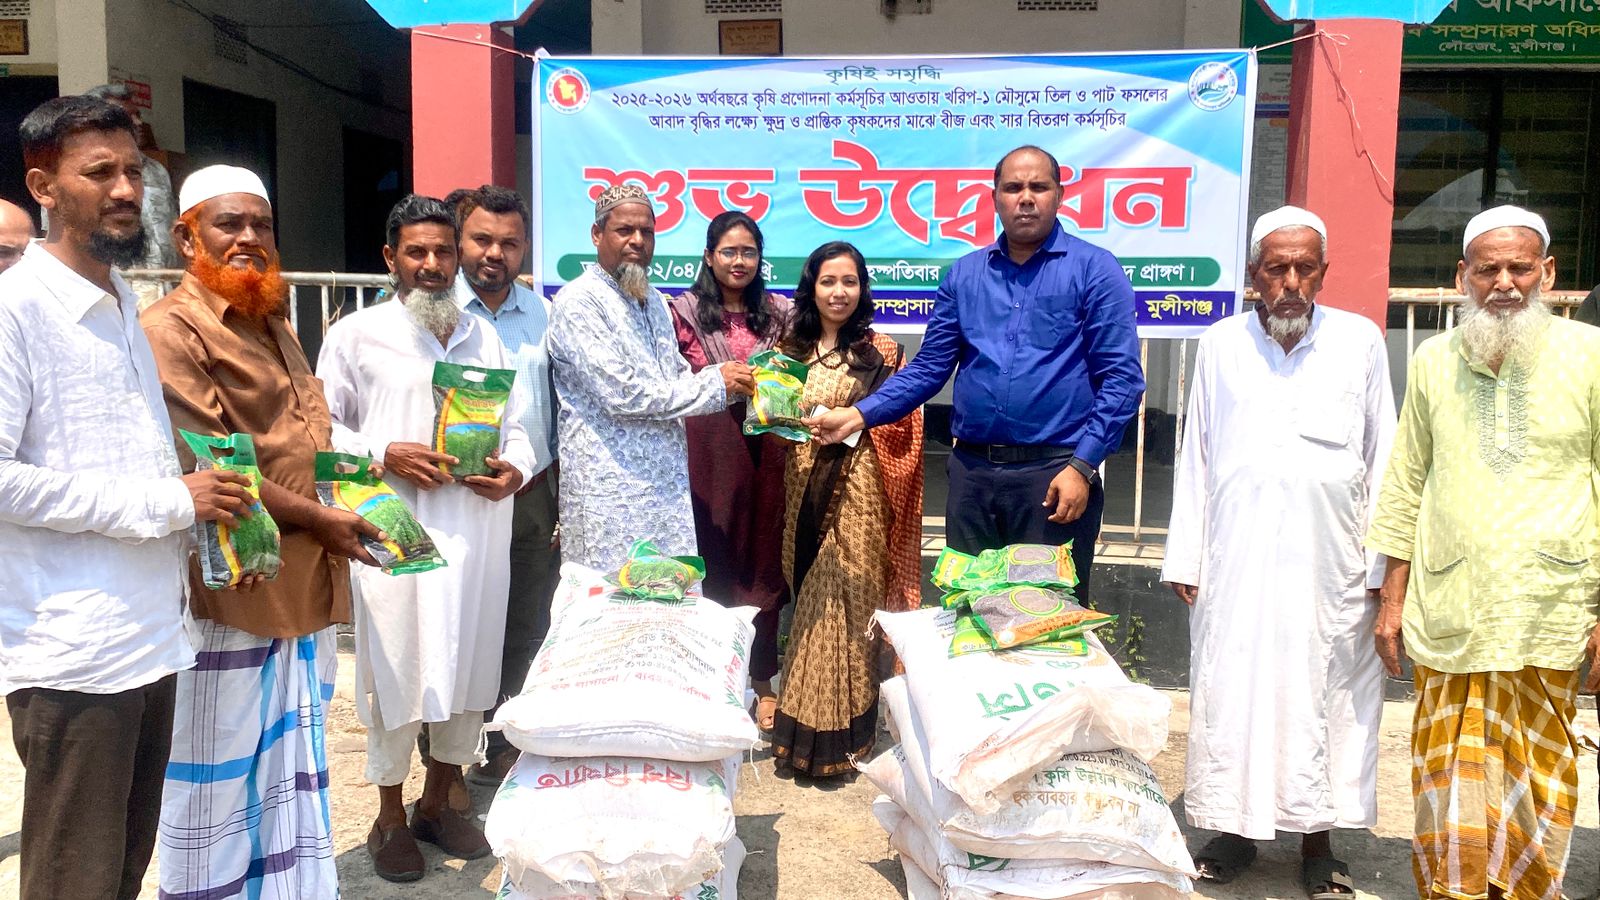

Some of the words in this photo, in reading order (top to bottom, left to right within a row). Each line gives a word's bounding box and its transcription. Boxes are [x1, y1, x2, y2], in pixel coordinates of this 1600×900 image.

[1431, 23, 1537, 40] সম্প্রসারণ
[824, 66, 880, 85] কৃষিই
[885, 65, 943, 85] সমৃদ্ধি
[612, 92, 692, 107] ২০২৫-২০২৬
[696, 88, 748, 107] অর্থবছরে
[753, 88, 777, 112] কৃষি
[781, 91, 830, 107] প্রণোদনা
[836, 88, 885, 111] কর্মসূচির
[890, 91, 940, 106] আওতায়
[944, 87, 990, 105] খরিপ-১
[995, 85, 1040, 107] মৌসুমে
[1045, 85, 1071, 104] তিল
[1076, 90, 1087, 102] ও
[1091, 85, 1116, 103] পাট
[1120, 88, 1168, 102] ফসলের
[649, 115, 686, 129] আবাদ
[690, 111, 721, 134] বৃদ্ধির
[724, 115, 758, 129] লক্ষ্যে
[763, 115, 786, 133] ক্ষুদ্র
[790, 116, 800, 128] ও
[804, 111, 842, 129] প্রান্তিক
[847, 114, 900, 135] কৃষকদের
[905, 114, 937, 129] মাঝে
[940, 110, 966, 129] বীজ
[970, 114, 996, 128] এবং
[1000, 113, 1023, 128] সার
[1028, 110, 1070, 127] বিতরণ
[1074, 108, 1126, 131] কর্মসূচির
[866, 259, 941, 282] হস্পতিবার
[1140, 263, 1185, 282] প্রাঙ্গণ
[872, 298, 935, 318] সম্প্রসা
[1145, 294, 1213, 320] মুন্সীগঞ্জ
[1043, 766, 1071, 788] কৃষি
